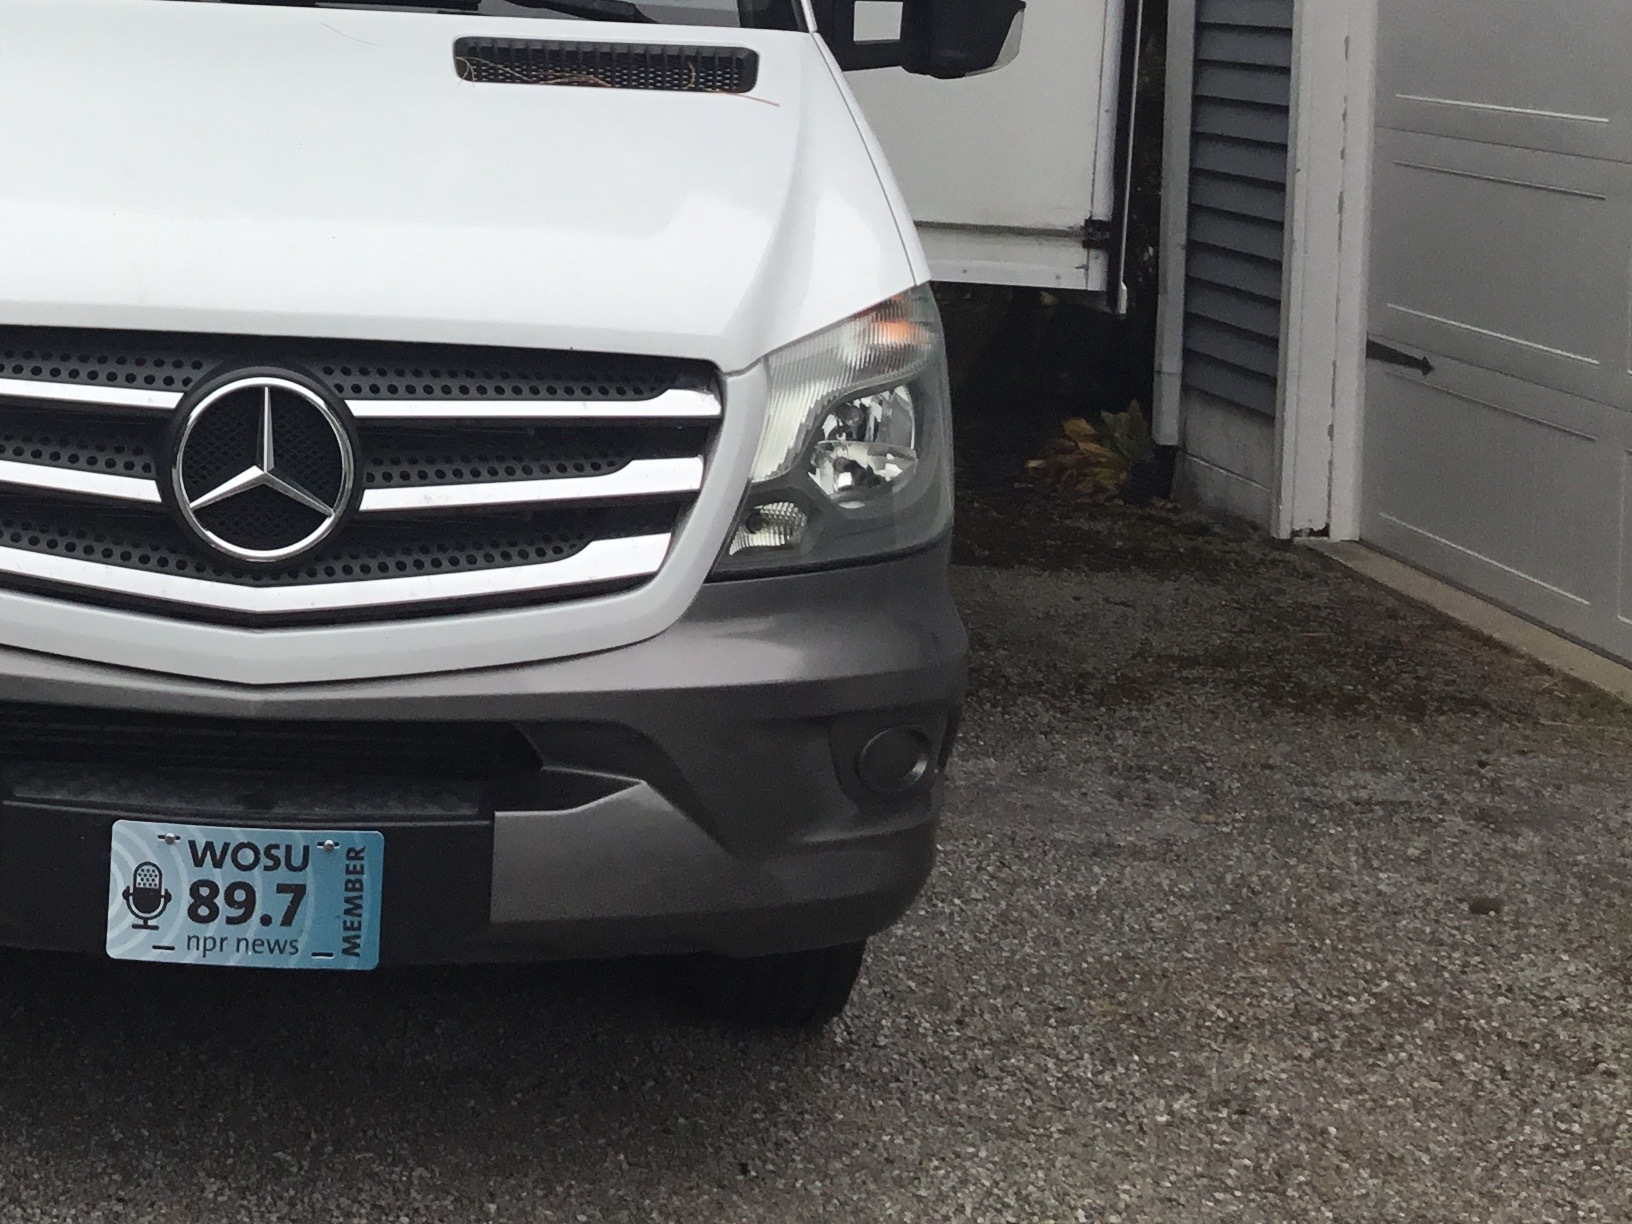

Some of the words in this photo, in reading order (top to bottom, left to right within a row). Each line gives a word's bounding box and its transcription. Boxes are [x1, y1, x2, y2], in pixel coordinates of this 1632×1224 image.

[187, 839, 310, 873] WOSU
[186, 878, 308, 927] 89.7
[341, 845, 366, 958] MEMBER
[186, 934, 228, 958] npr
[235, 937, 300, 956] news
